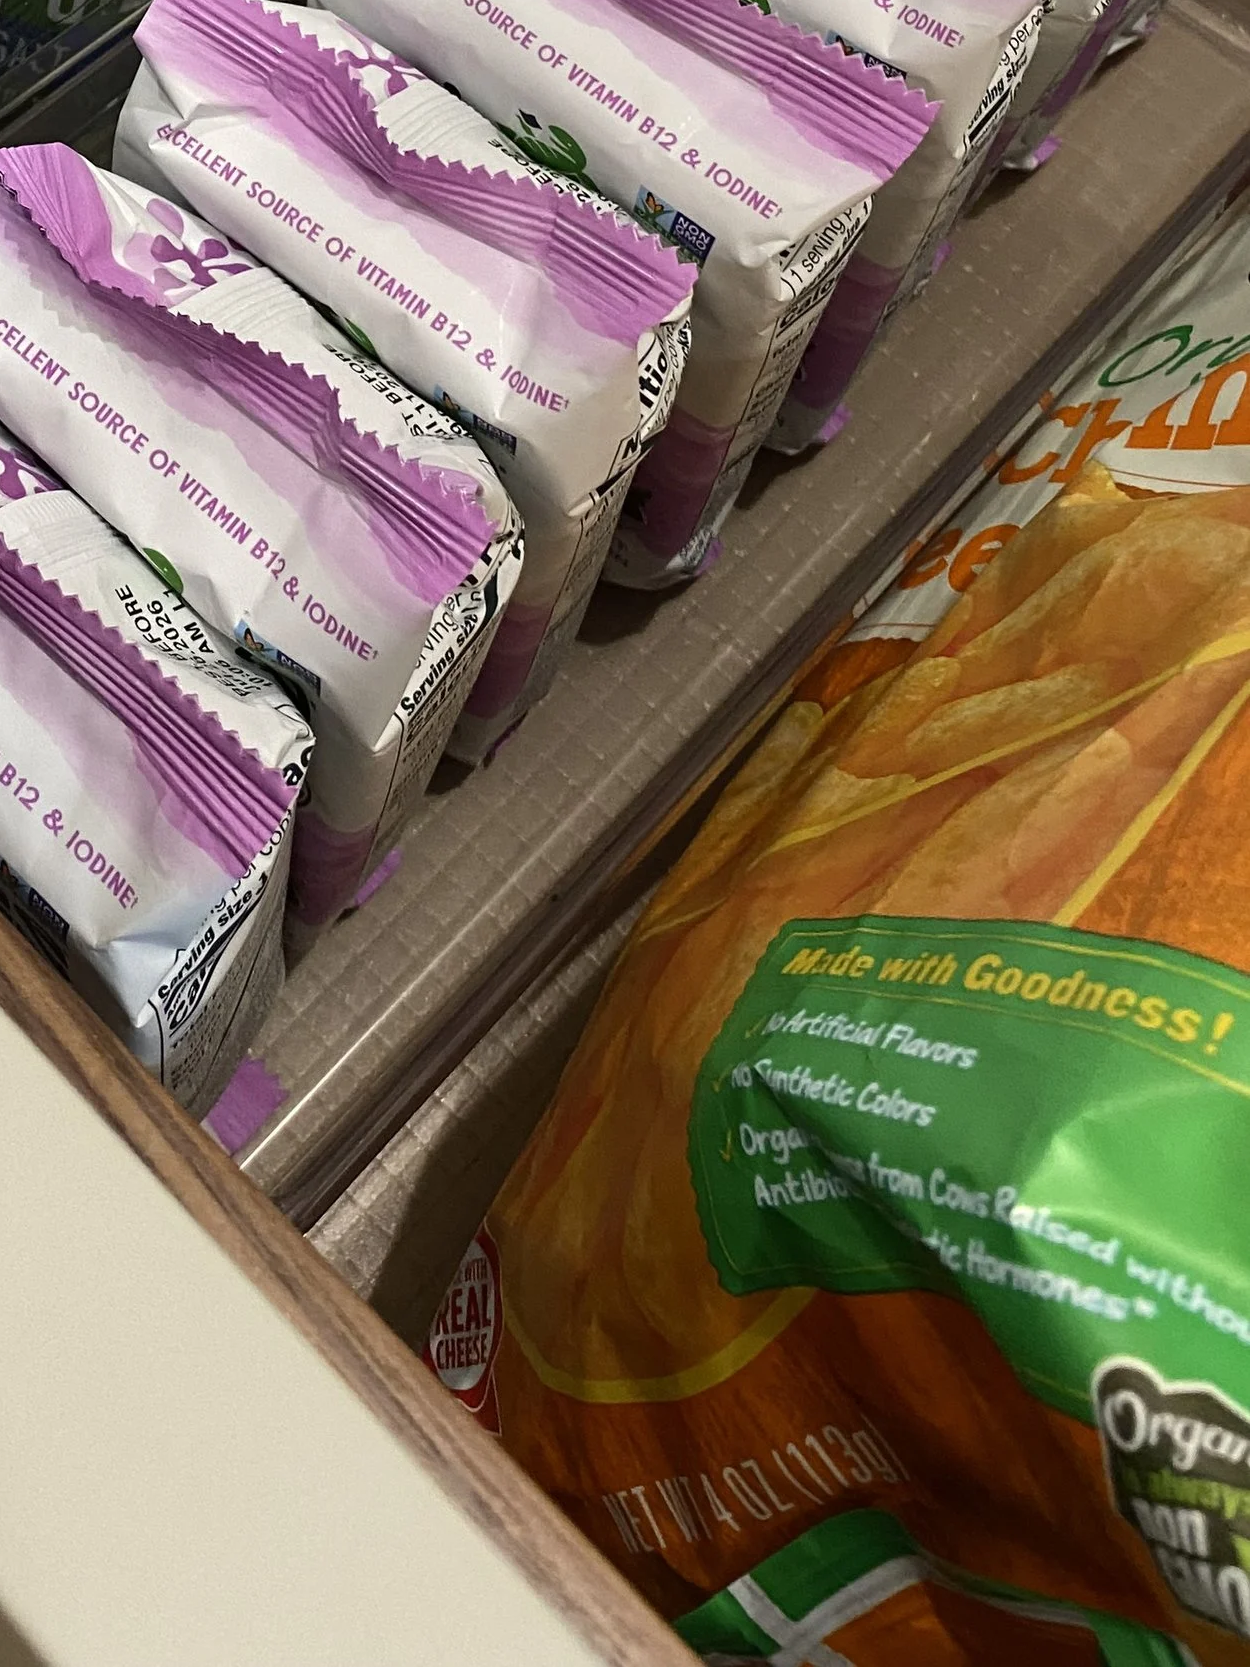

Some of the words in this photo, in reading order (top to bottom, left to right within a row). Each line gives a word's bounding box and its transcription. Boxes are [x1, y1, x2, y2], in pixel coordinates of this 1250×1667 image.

[538, 44, 568, 70] OF
[568, 64, 640, 124] VITAMIN
[638, 115, 678, 153] B12
[680, 148, 701, 171] &
[677, 216, 712, 245] NON
[801, 217, 847, 273] serving
[247, 181, 324, 244] SOURCE
[325, 236, 356, 263] OF
[357, 256, 431, 320] VITAMIN
[431, 310, 471, 352] B12
[476, 348, 497, 372] &
[69, 381, 149, 455] SOURCE
[149, 448, 181, 479] OF
[179, 473, 253, 546] VITAMIN
[250, 537, 287, 579] B12
[282, 576, 301, 602] &
[114, 584, 189, 662] BEFORE
[183, 622, 214, 654] AM
[400, 648, 455, 716] Serving
[42, 808, 64, 837] &
[218, 887, 254, 927] size
[782, 947, 874, 983] Made
[877, 950, 957, 986] with
[963, 952, 1234, 1056] Goodness!
[783, 1009, 885, 1049] Artificial
[880, 1023, 979, 1069] Flavors
[856, 1082, 937, 1127] Colors
[868, 1151, 925, 1201] from
[435, 1334, 488, 1370] CHEESE
[602, 1485, 667, 1553] NET
[657, 1475, 710, 1542] WT
[703, 1472, 740, 1532] 4
[723, 1458, 793, 1522] OZ
